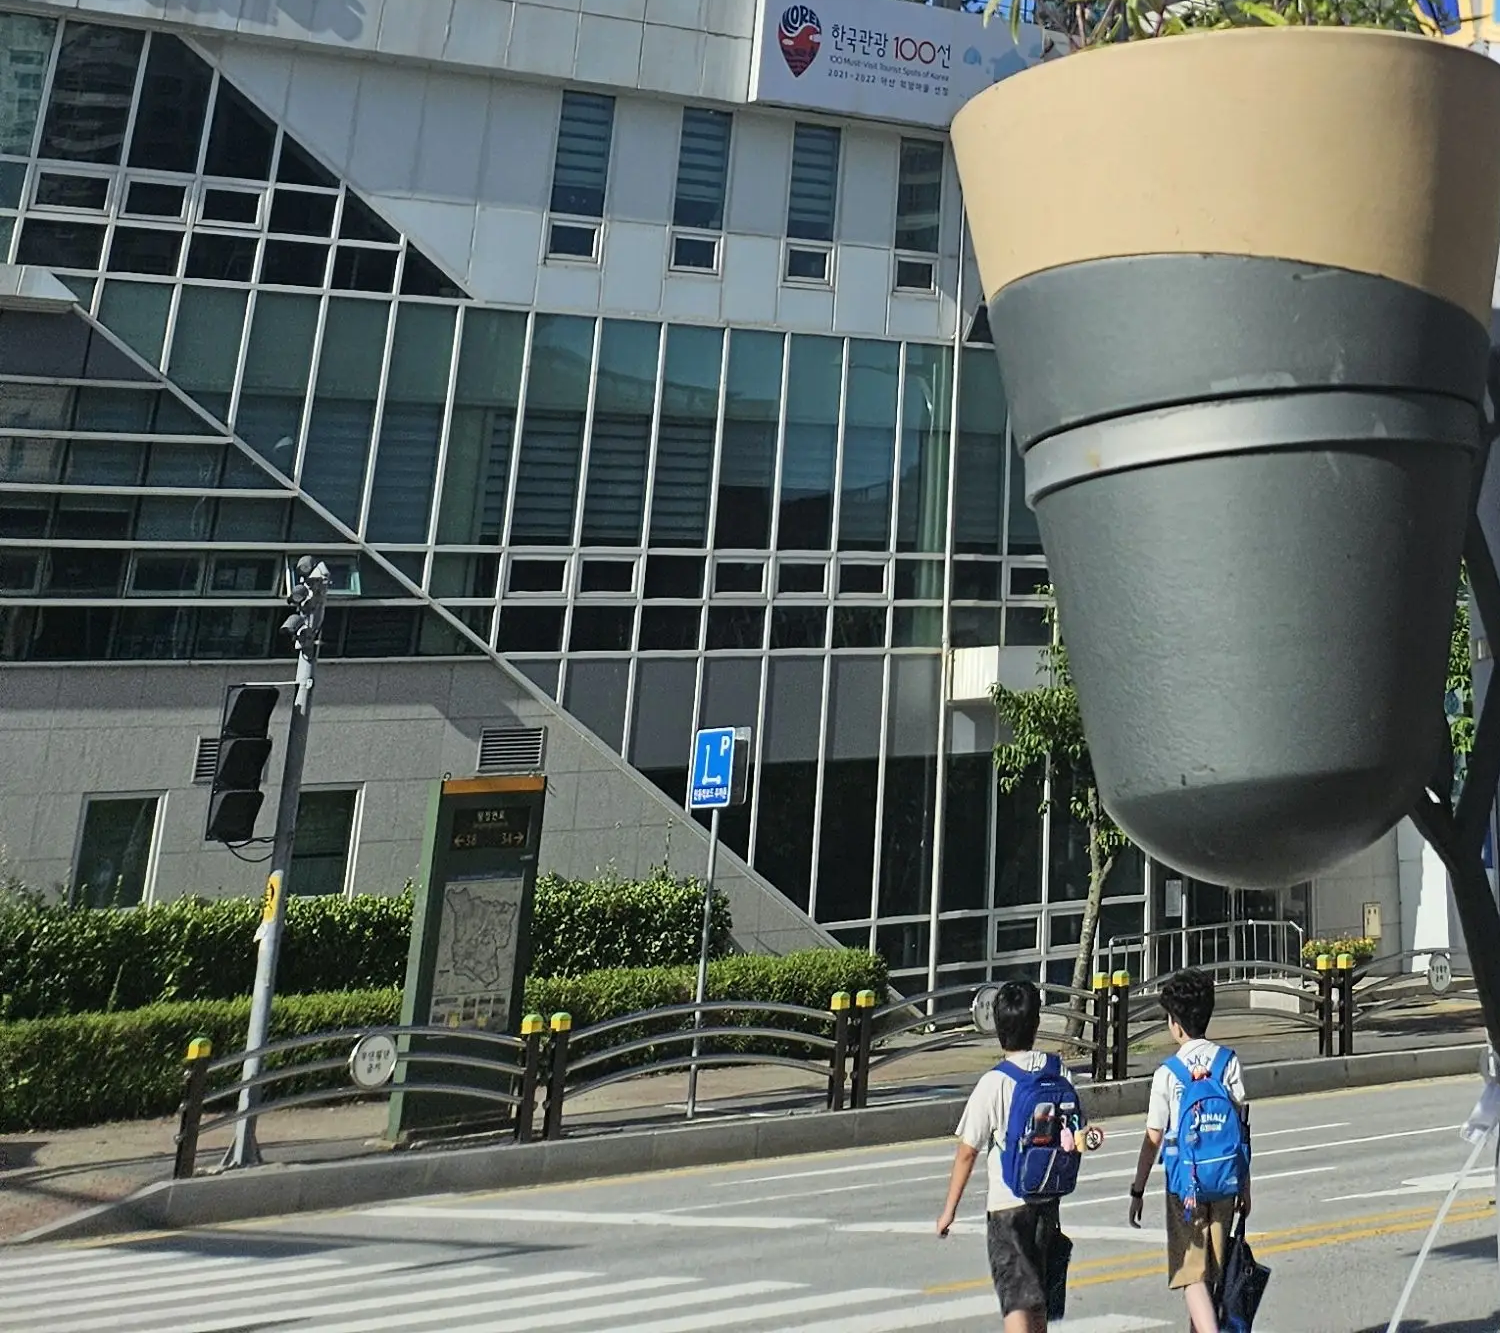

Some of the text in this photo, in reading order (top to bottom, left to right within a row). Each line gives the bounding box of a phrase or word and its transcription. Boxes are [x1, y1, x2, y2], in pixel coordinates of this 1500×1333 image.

[831, 24, 952, 69] 한국관광 100선
[719, 735, 731, 757] P
